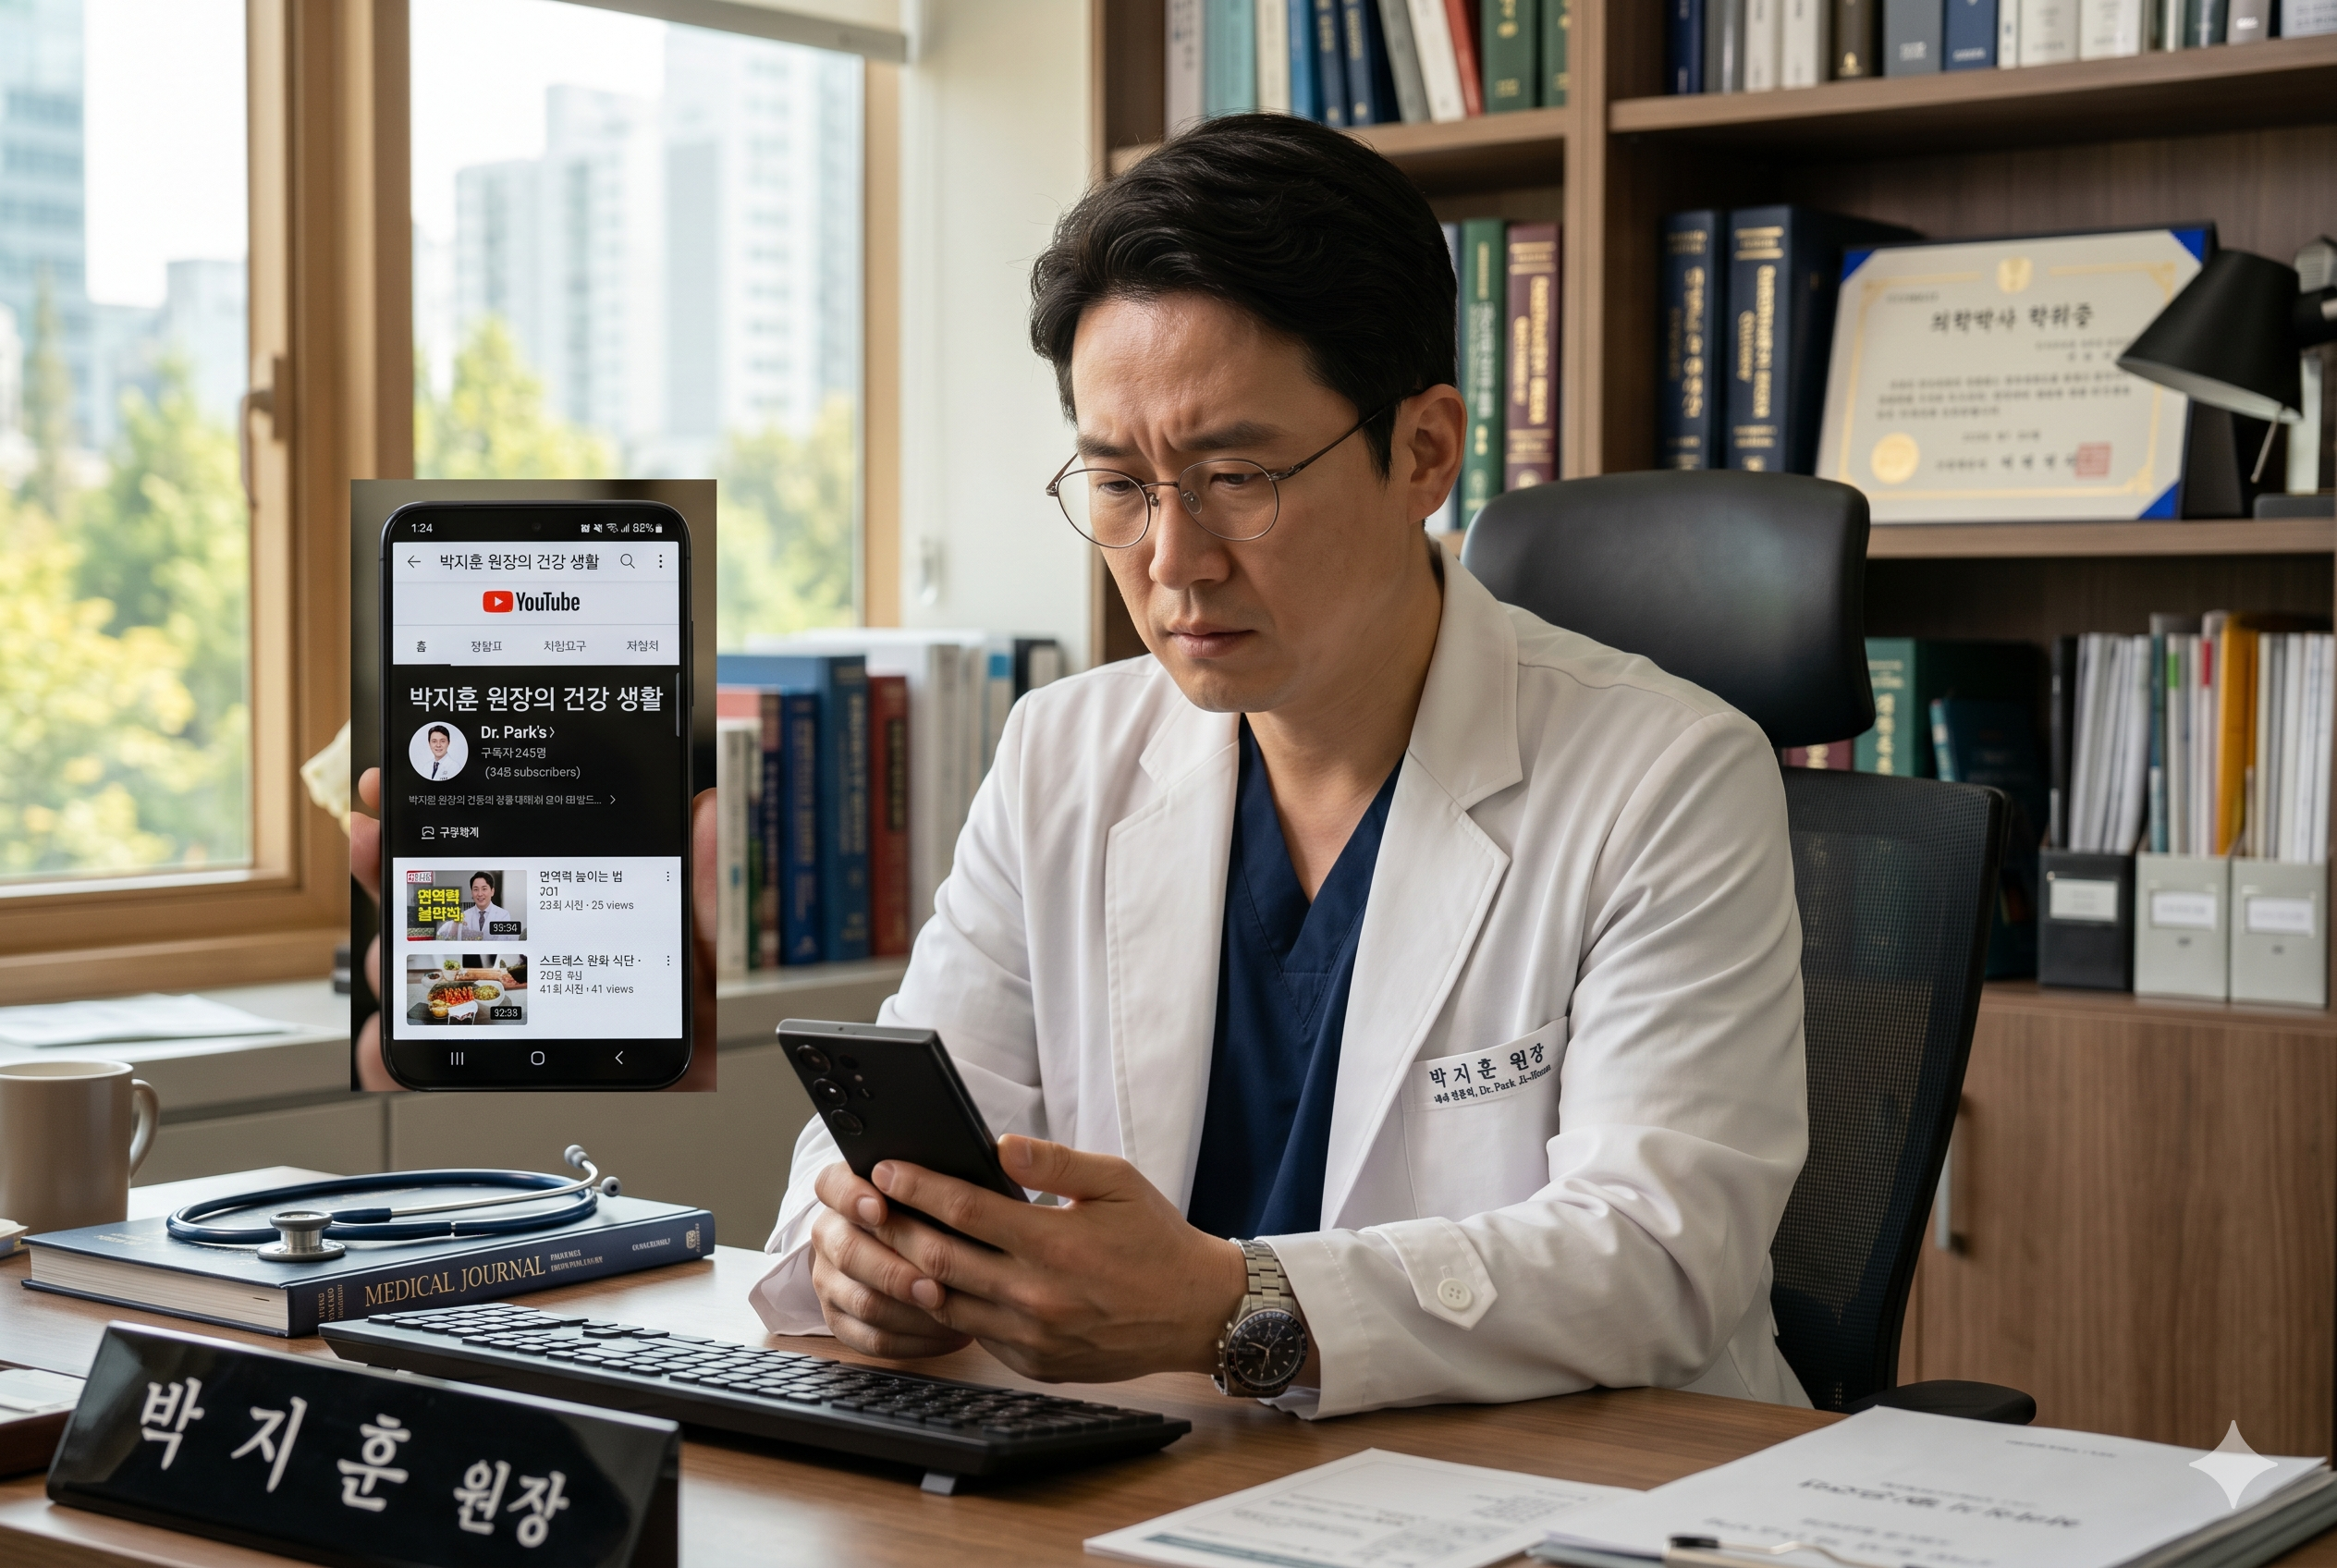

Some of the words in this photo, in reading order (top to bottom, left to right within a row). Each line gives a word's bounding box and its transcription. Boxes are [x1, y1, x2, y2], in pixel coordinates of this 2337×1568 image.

[411, 523, 433, 533] 1:24
[441, 554, 483, 570] 박지훈
[488, 555, 531, 570] 원장의
[537, 555, 566, 570] 건강
[570, 554, 599, 570] 생활
[516, 592, 580, 611] YouTube
[410, 687, 478, 712] 박지훈
[486, 687, 554, 712] 원장의
[564, 687, 609, 711] 건강
[617, 687, 663, 711] 생활
[482, 726, 499, 738] Dr.
[505, 726, 546, 738] Park's
[514, 766, 580, 778] subscribers)
[592, 900, 604, 909] 25
[606, 900, 633, 909] views
[540, 955, 583, 967] 스트레스
[613, 955, 634, 966] 식단
[592, 985, 602, 993] 41
[606, 985, 633, 993] views
[1510, 1042, 1545, 1072] 원장
[365, 1271, 454, 1307] MEDICAL
[460, 1256, 545, 1292] JOURNAL
[453, 1459, 569, 1549] 원장
